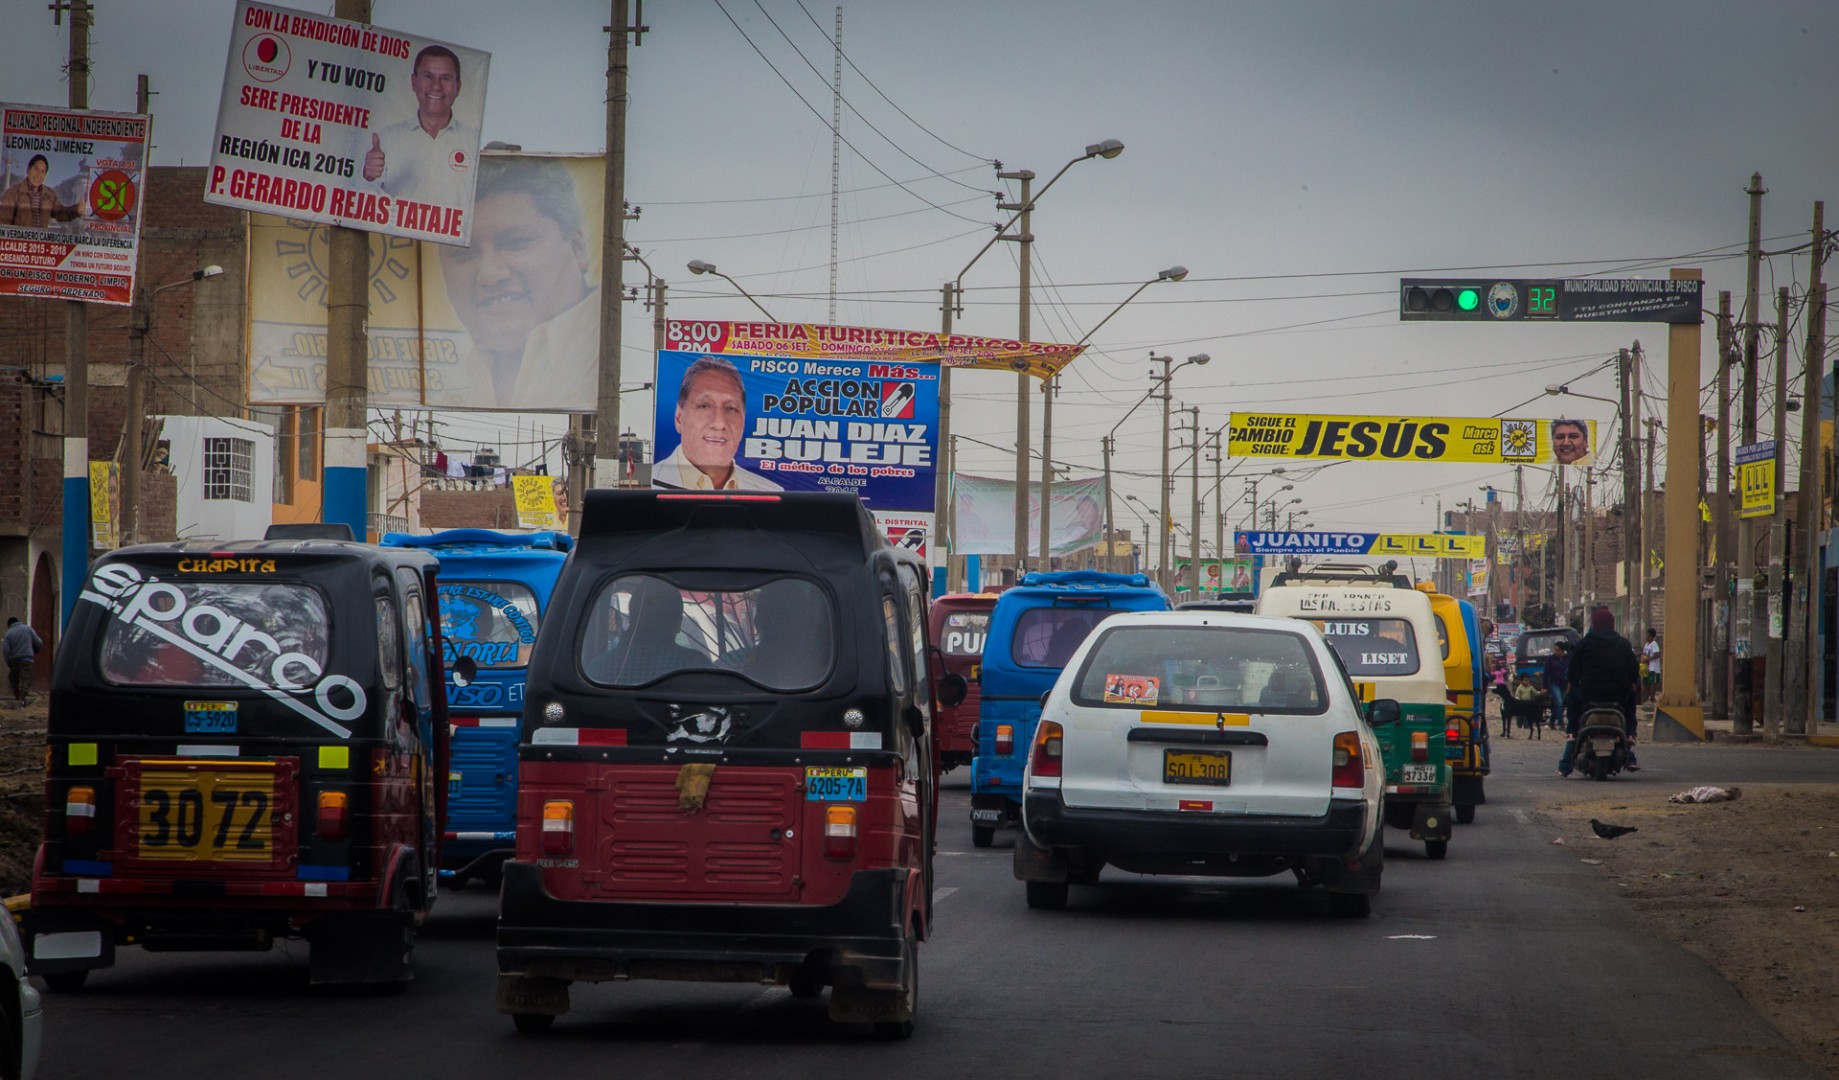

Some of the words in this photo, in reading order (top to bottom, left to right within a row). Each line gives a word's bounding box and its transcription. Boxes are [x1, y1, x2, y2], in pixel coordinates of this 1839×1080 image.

[245, 6, 272, 29] CON
[273, 13, 289, 34] LA
[291, 15, 360, 49] BENDICIÓN
[362, 32, 378, 52] DE
[379, 34, 411, 60] DIOS
[248, 64, 283, 76] LIBERTAD
[307, 59, 319, 78] Y
[321, 62, 340, 84] TU
[344, 66, 386, 93] VOTO
[240, 84, 278, 110] SERE
[280, 92, 371, 130] PRESIDENTE
[8, 113, 41, 130] ALIANZA
[42, 115, 82, 132] REGIONAL
[84, 119, 144, 138] INDEPENDIENTE
[281, 118, 300, 140] DE
[303, 123, 322, 144] LA
[6, 136, 52, 151] LEONIDAS
[96, 159, 118, 168] VOTA
[219, 135, 280, 165] REGIÓN
[282, 147, 310, 170] ICA
[314, 154, 355, 178] 2015
[210, 165, 224, 195] P.
[229, 169, 326, 214] GERARDO
[330, 187, 390, 225] REJAS
[395, 198, 464, 238] TATAJE
[90, 222, 132, 232] PROVINCIAL
[7, 230, 38, 240] VERDADERO
[40, 232, 60, 242] CAMBIO
[62, 234, 73, 243] QUE
[74, 236, 93, 245] MARCA
[94, 238, 101, 246] LA
[0, 242, 28, 252] LCALDE
[28, 244, 45, 254] 2015
[50, 245, 67, 256] 2018
[0, 253, 30, 263] CREANDO
[31, 254, 56, 265] FUTURO
[0, 268, 11, 276] OR
[14, 270, 25, 278] UN
[28, 271, 52, 279] PISCO
[56, 272, 98, 286] MODERNO,
[99, 276, 128, 288] LIMPIO,
[18, 284, 51, 294] SEGURO
[54, 286, 59, 294] Y
[61, 288, 105, 298] ORDENADO
[1564, 280, 1619, 292] MUNICIPALIDAD
[1620, 280, 1664, 292] PROVINCIAL
[1665, 280, 1675, 292] DE
[1676, 281, 1698, 293] PISCO
[1530, 288, 1555, 311] 32
[1599, 298, 1662, 309] CONFIANZA
[1575, 308, 1628, 318] NUESTRA
[668, 321, 722, 342] 8:00
[733, 322, 808, 340] FERIA
[815, 326, 941, 347] TURISTICA
[948, 335, 1022, 352] PISCO
[678, 342, 712, 352] PM
[732, 340, 774, 350] SABADO
[775, 342, 788, 350] 06
[791, 342, 810, 352] SET.
[821, 342, 870, 353] DOMINGO
[750, 360, 798, 374] PISCO
[804, 362, 861, 376] Merece
[868, 364, 936, 380] Más...
[784, 378, 880, 399] ACCION
[763, 394, 878, 417] POPULAR
[1247, 416, 1281, 427] SIGUE
[1284, 418, 1296, 428] EL
[752, 417, 839, 440] JUAN
[847, 422, 927, 444] DIAZ
[1228, 427, 1294, 443] CAMBIO
[1463, 426, 1499, 440] Marca
[1294, 419, 1450, 458] JESÚS
[744, 438, 932, 467] BULEJE
[1251, 444, 1289, 455] SIGUE:
[1473, 441, 1495, 454] así:
[760, 460, 776, 470] El
[779, 461, 824, 474] médico
[828, 463, 843, 474] de
[849, 466, 867, 475] los
[872, 466, 915, 478] pobres
[818, 477, 867, 486] ALCALDE
[885, 519, 928, 527] DISTRITAL
[1252, 534, 1365, 547] JUANITO
[1387, 537, 1403, 548] L
[1418, 538, 1434, 549] L
[1449, 539, 1464, 550] L
[178, 557, 276, 574] CHAPITA
[1324, 622, 1369, 635] LUIS
[1361, 653, 1408, 665] LISET
[810, 778, 863, 796] 6205-7A
[142, 789, 270, 850] 3072
